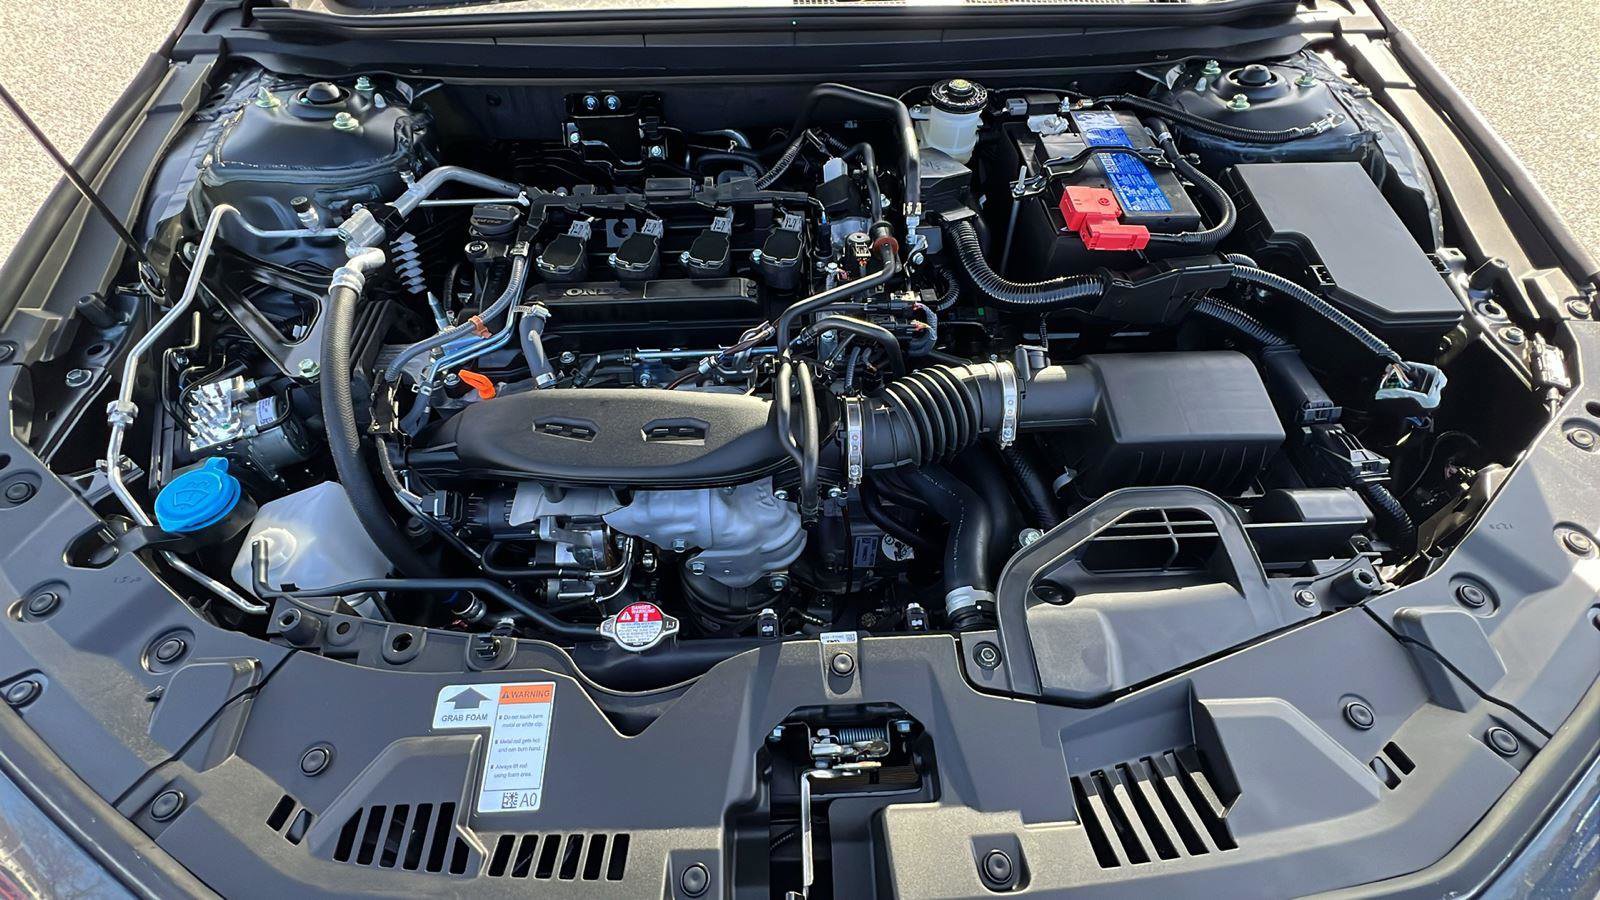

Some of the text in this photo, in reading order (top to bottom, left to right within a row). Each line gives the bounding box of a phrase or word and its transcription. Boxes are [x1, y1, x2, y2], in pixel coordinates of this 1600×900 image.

[511, 690, 550, 698] WARNING
[441, 713, 488, 722] GRAB FOAM
